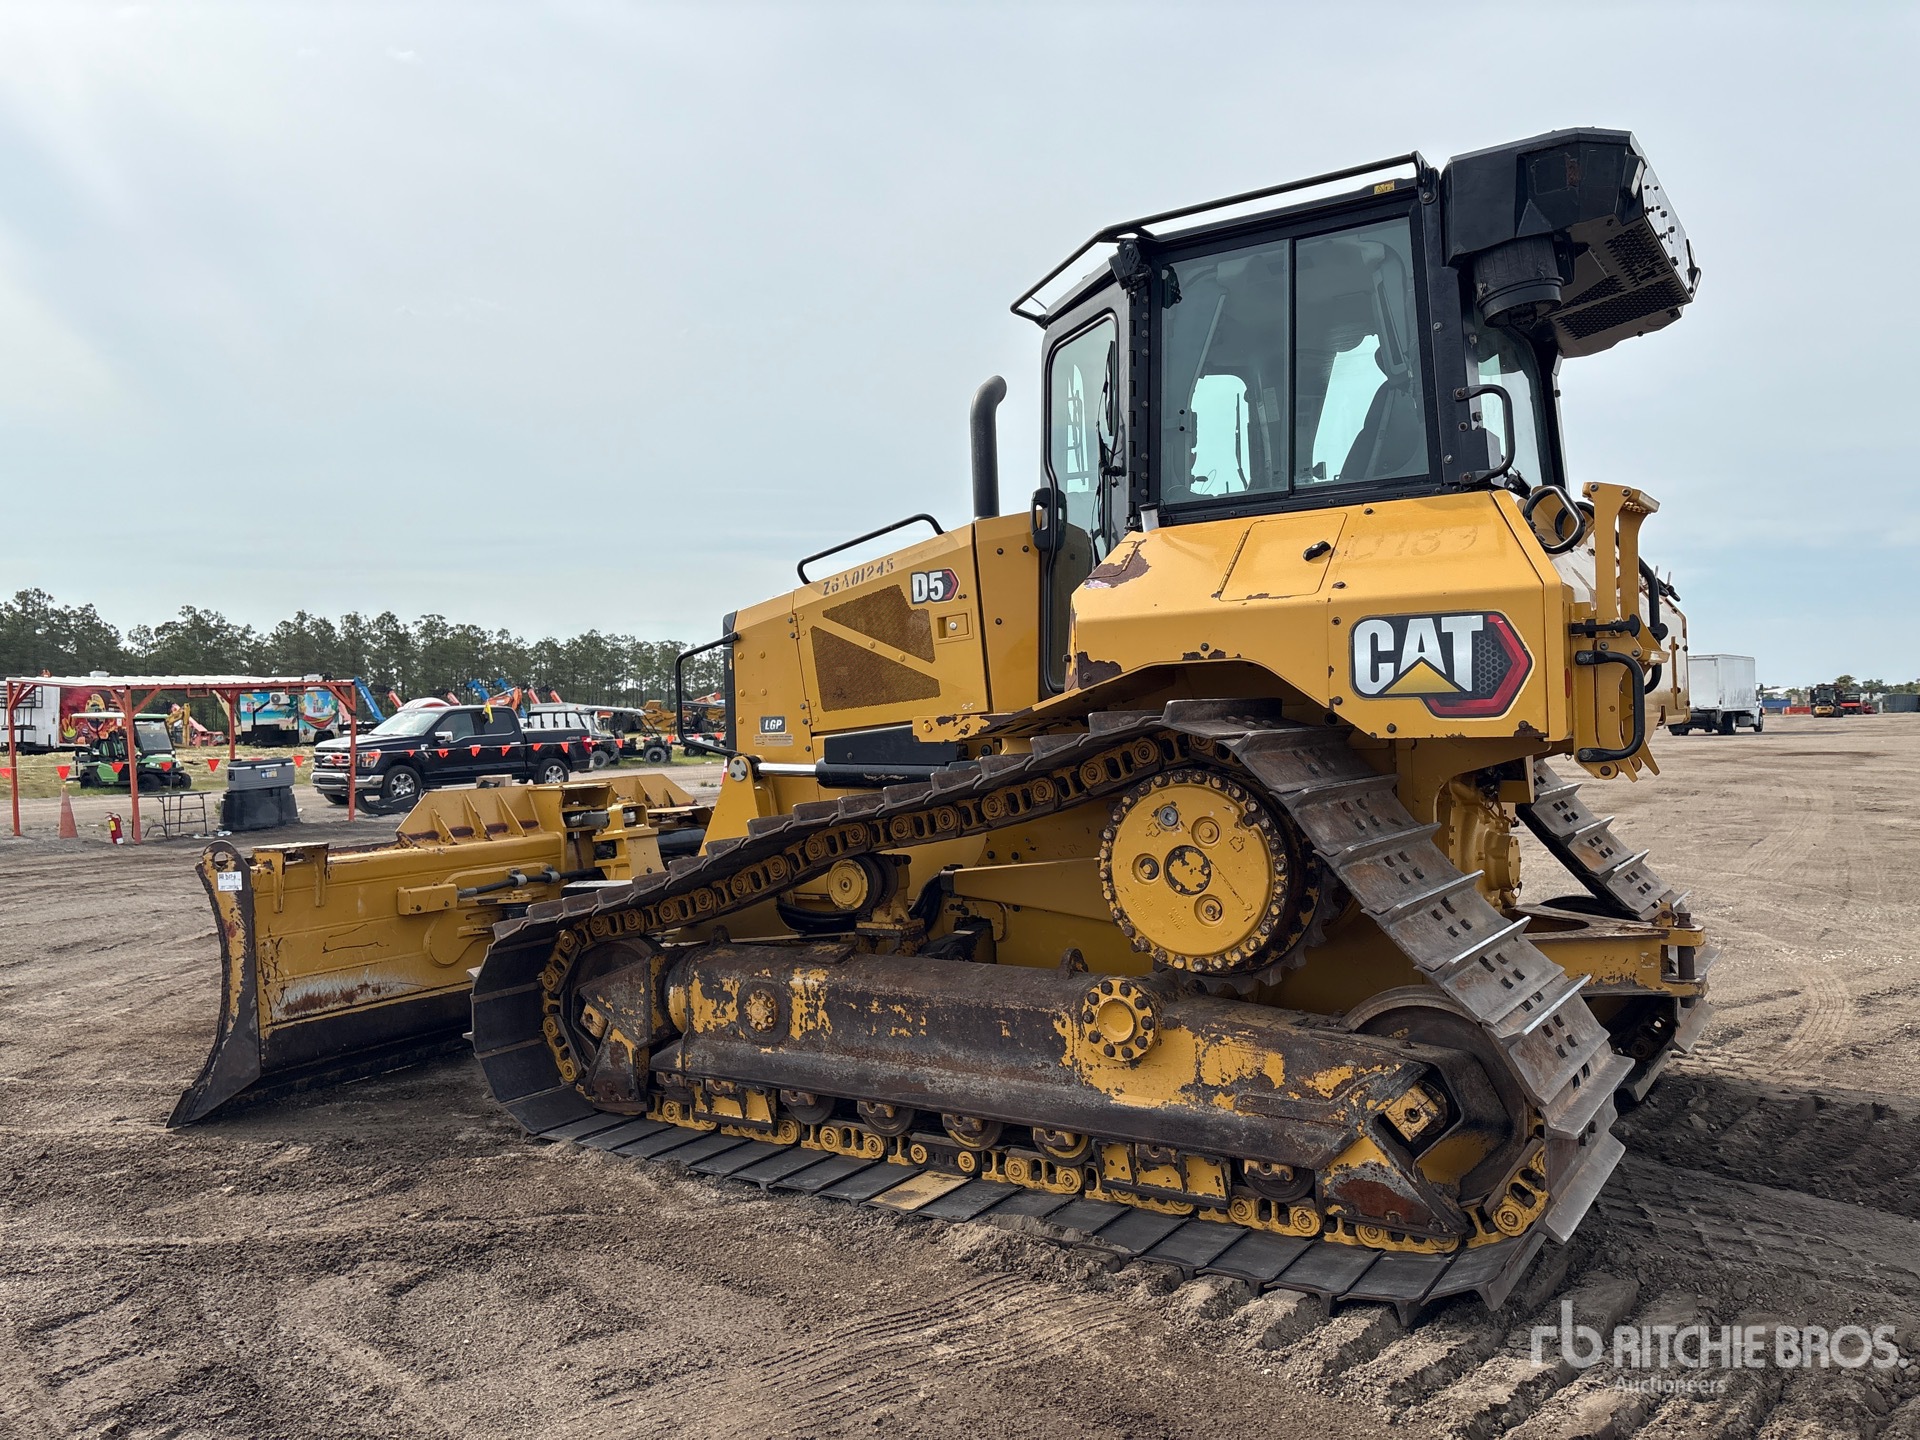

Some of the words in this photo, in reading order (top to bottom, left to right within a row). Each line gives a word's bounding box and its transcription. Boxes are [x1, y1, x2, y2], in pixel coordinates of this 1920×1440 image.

[912, 571, 944, 602] D5
[1354, 615, 1484, 695] CAT
[765, 719, 783, 731] LGP
